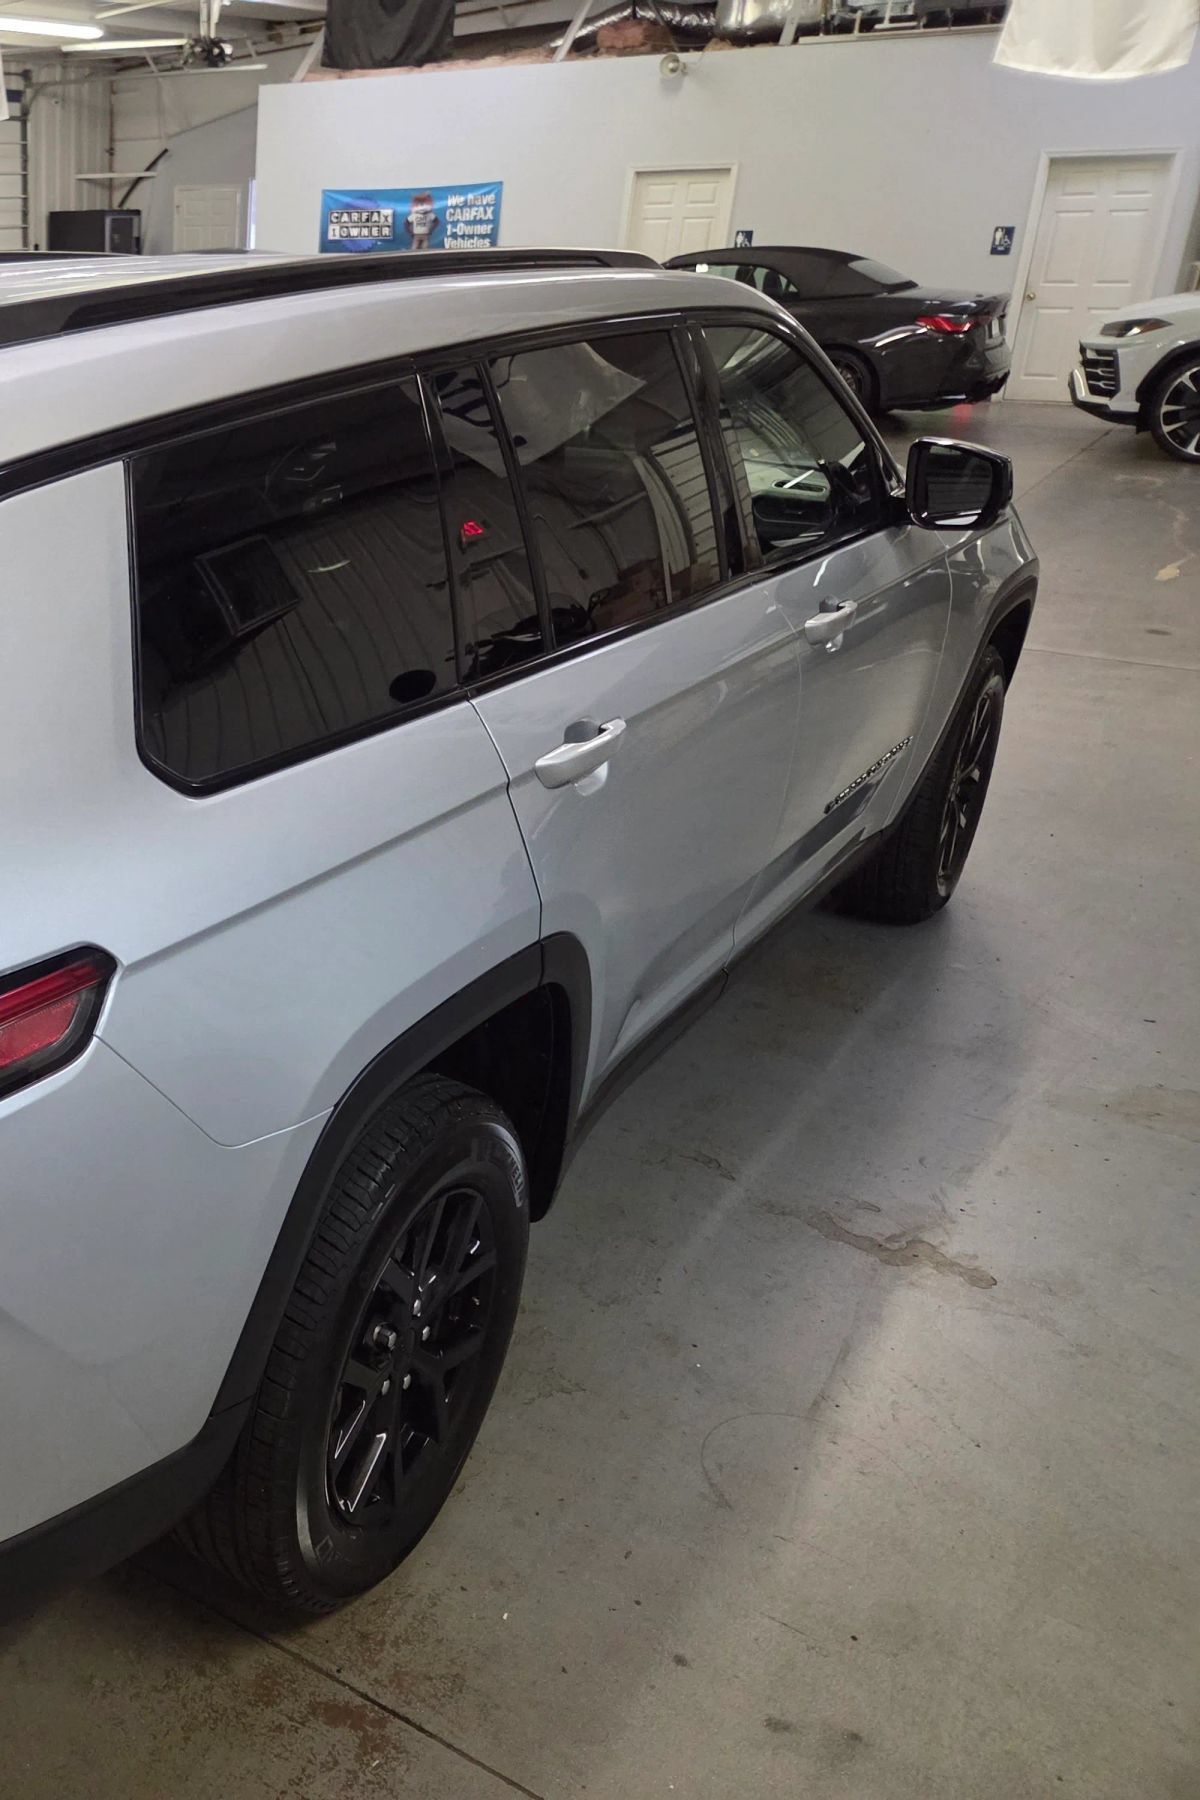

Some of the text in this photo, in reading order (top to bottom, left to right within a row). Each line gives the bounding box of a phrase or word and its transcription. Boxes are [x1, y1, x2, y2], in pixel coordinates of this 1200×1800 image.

[447, 192, 496, 207] We have
[330, 210, 391, 224] CARFAX
[446, 206, 494, 221] CARFAX
[446, 222, 493, 236] 1-Owner
[444, 236, 491, 249] Vehicles
